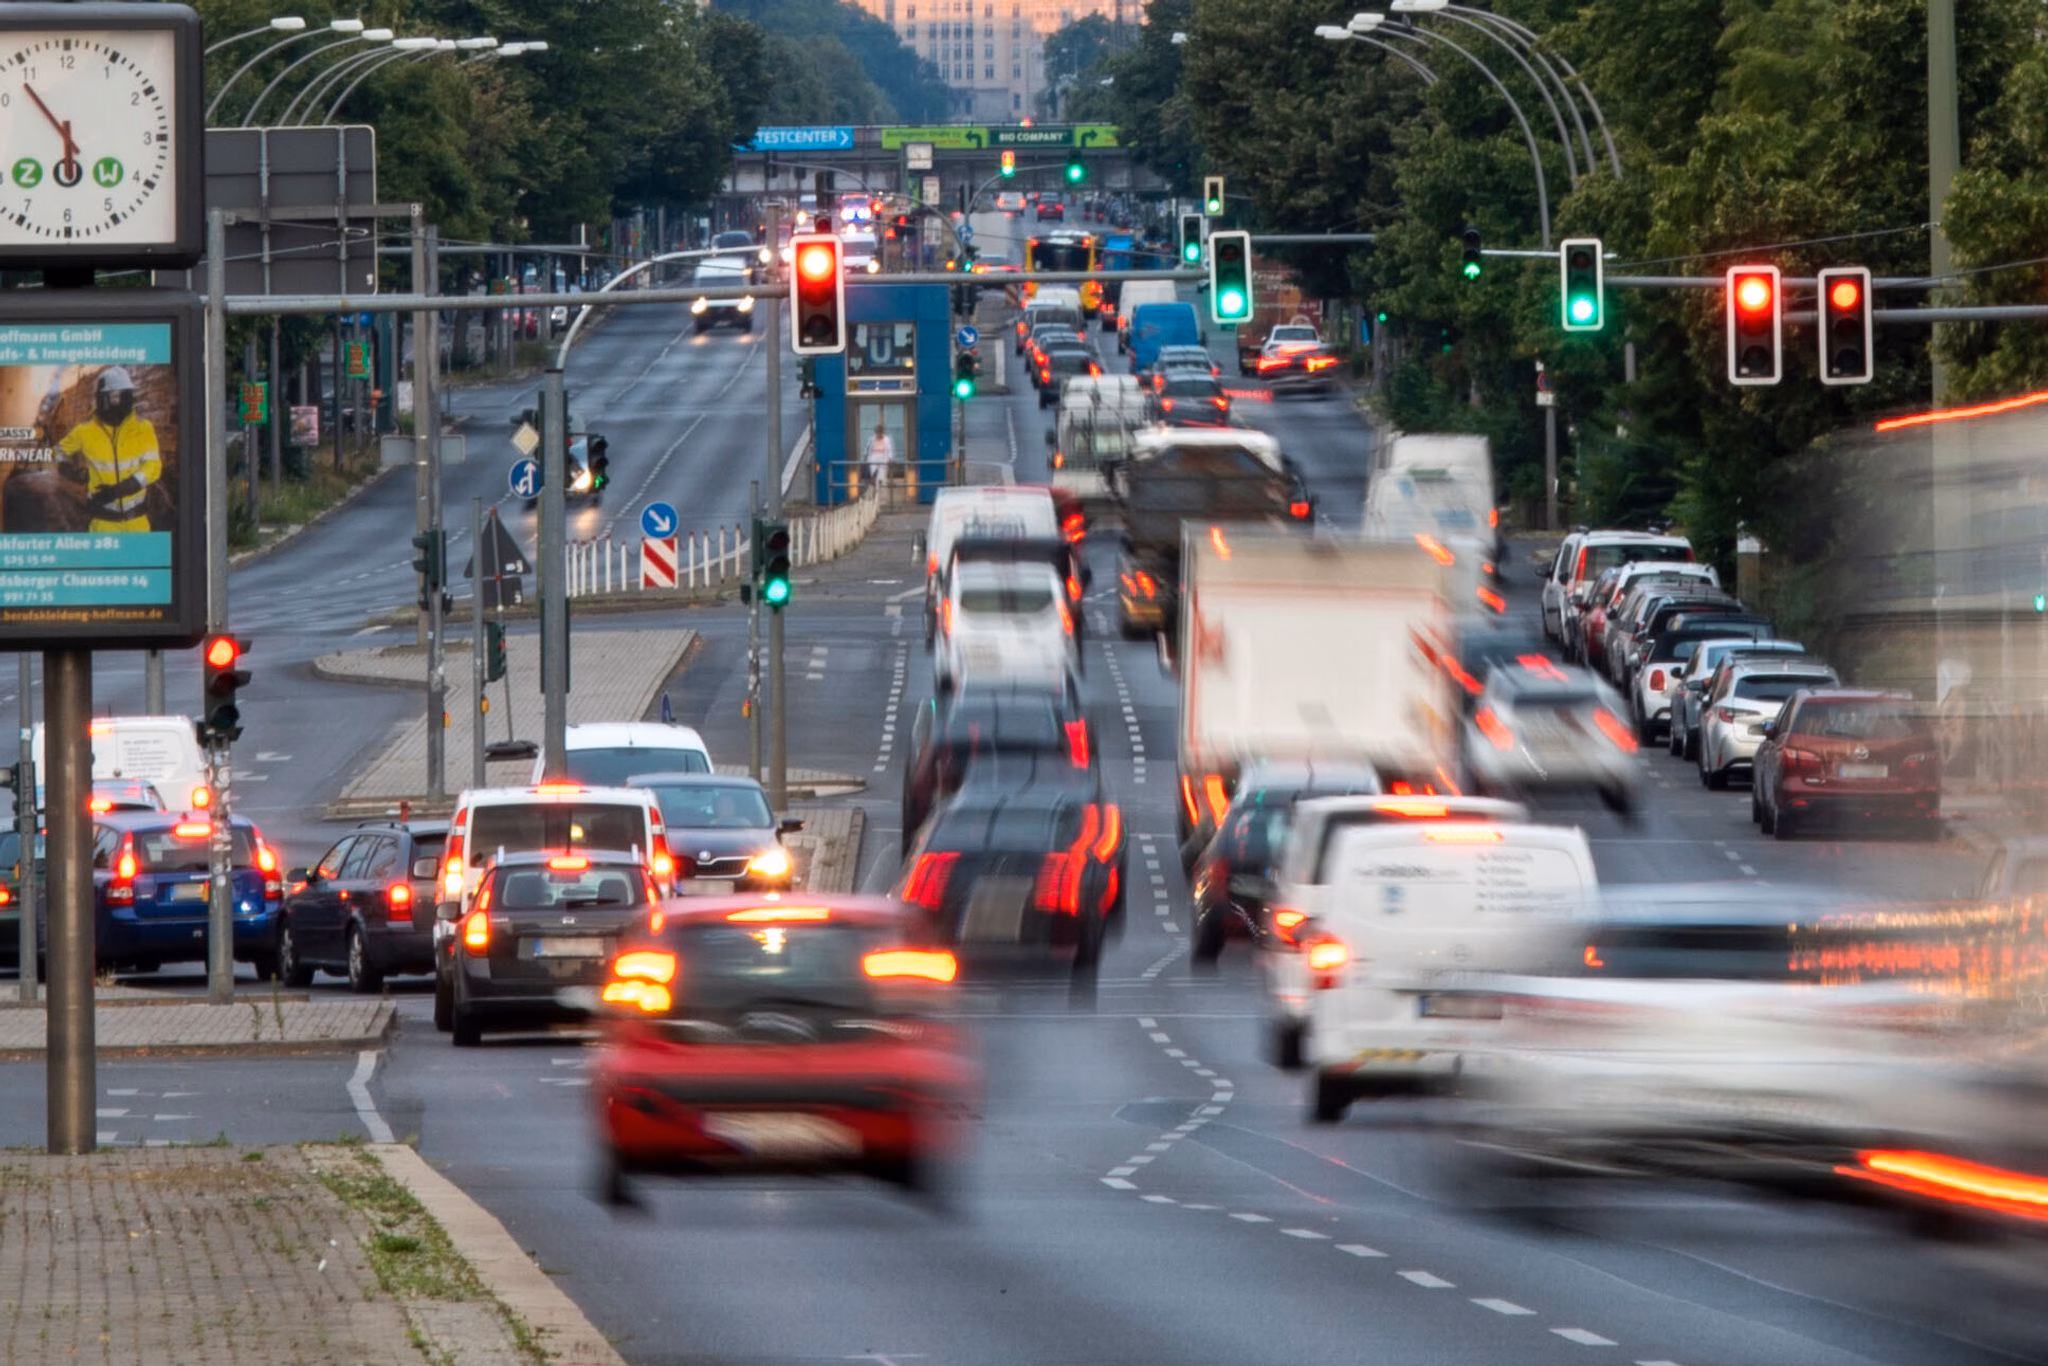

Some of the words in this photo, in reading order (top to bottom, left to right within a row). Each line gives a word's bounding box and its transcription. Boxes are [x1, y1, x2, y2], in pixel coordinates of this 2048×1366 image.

[60, 55, 75, 69] 12
[23, 67, 36, 80] 11
[104, 66, 110, 80] 1
[131, 92, 140, 106] 2
[143, 132, 152, 146] 3
[756, 129, 837, 144] TESTCENTER
[999, 132, 1015, 141] BIO
[1017, 132, 1063, 141] COMPANY
[19, 163, 36, 184] Z
[99, 163, 118, 183] W
[132, 170, 140, 182] 4
[24, 198, 32, 212] 7
[104, 198, 113, 212] 5
[63, 209, 72, 222] 6
[61, 330, 102, 342] GmbH
[28, 348, 38, 360] &
[42, 348, 146, 362] Imagekleidung
[869, 337, 892, 363] U
[55, 536, 91, 549] Allee
[94, 537, 119, 549] 281
[63, 573, 128, 586] Chaussee
[131, 574, 148, 588] 14
